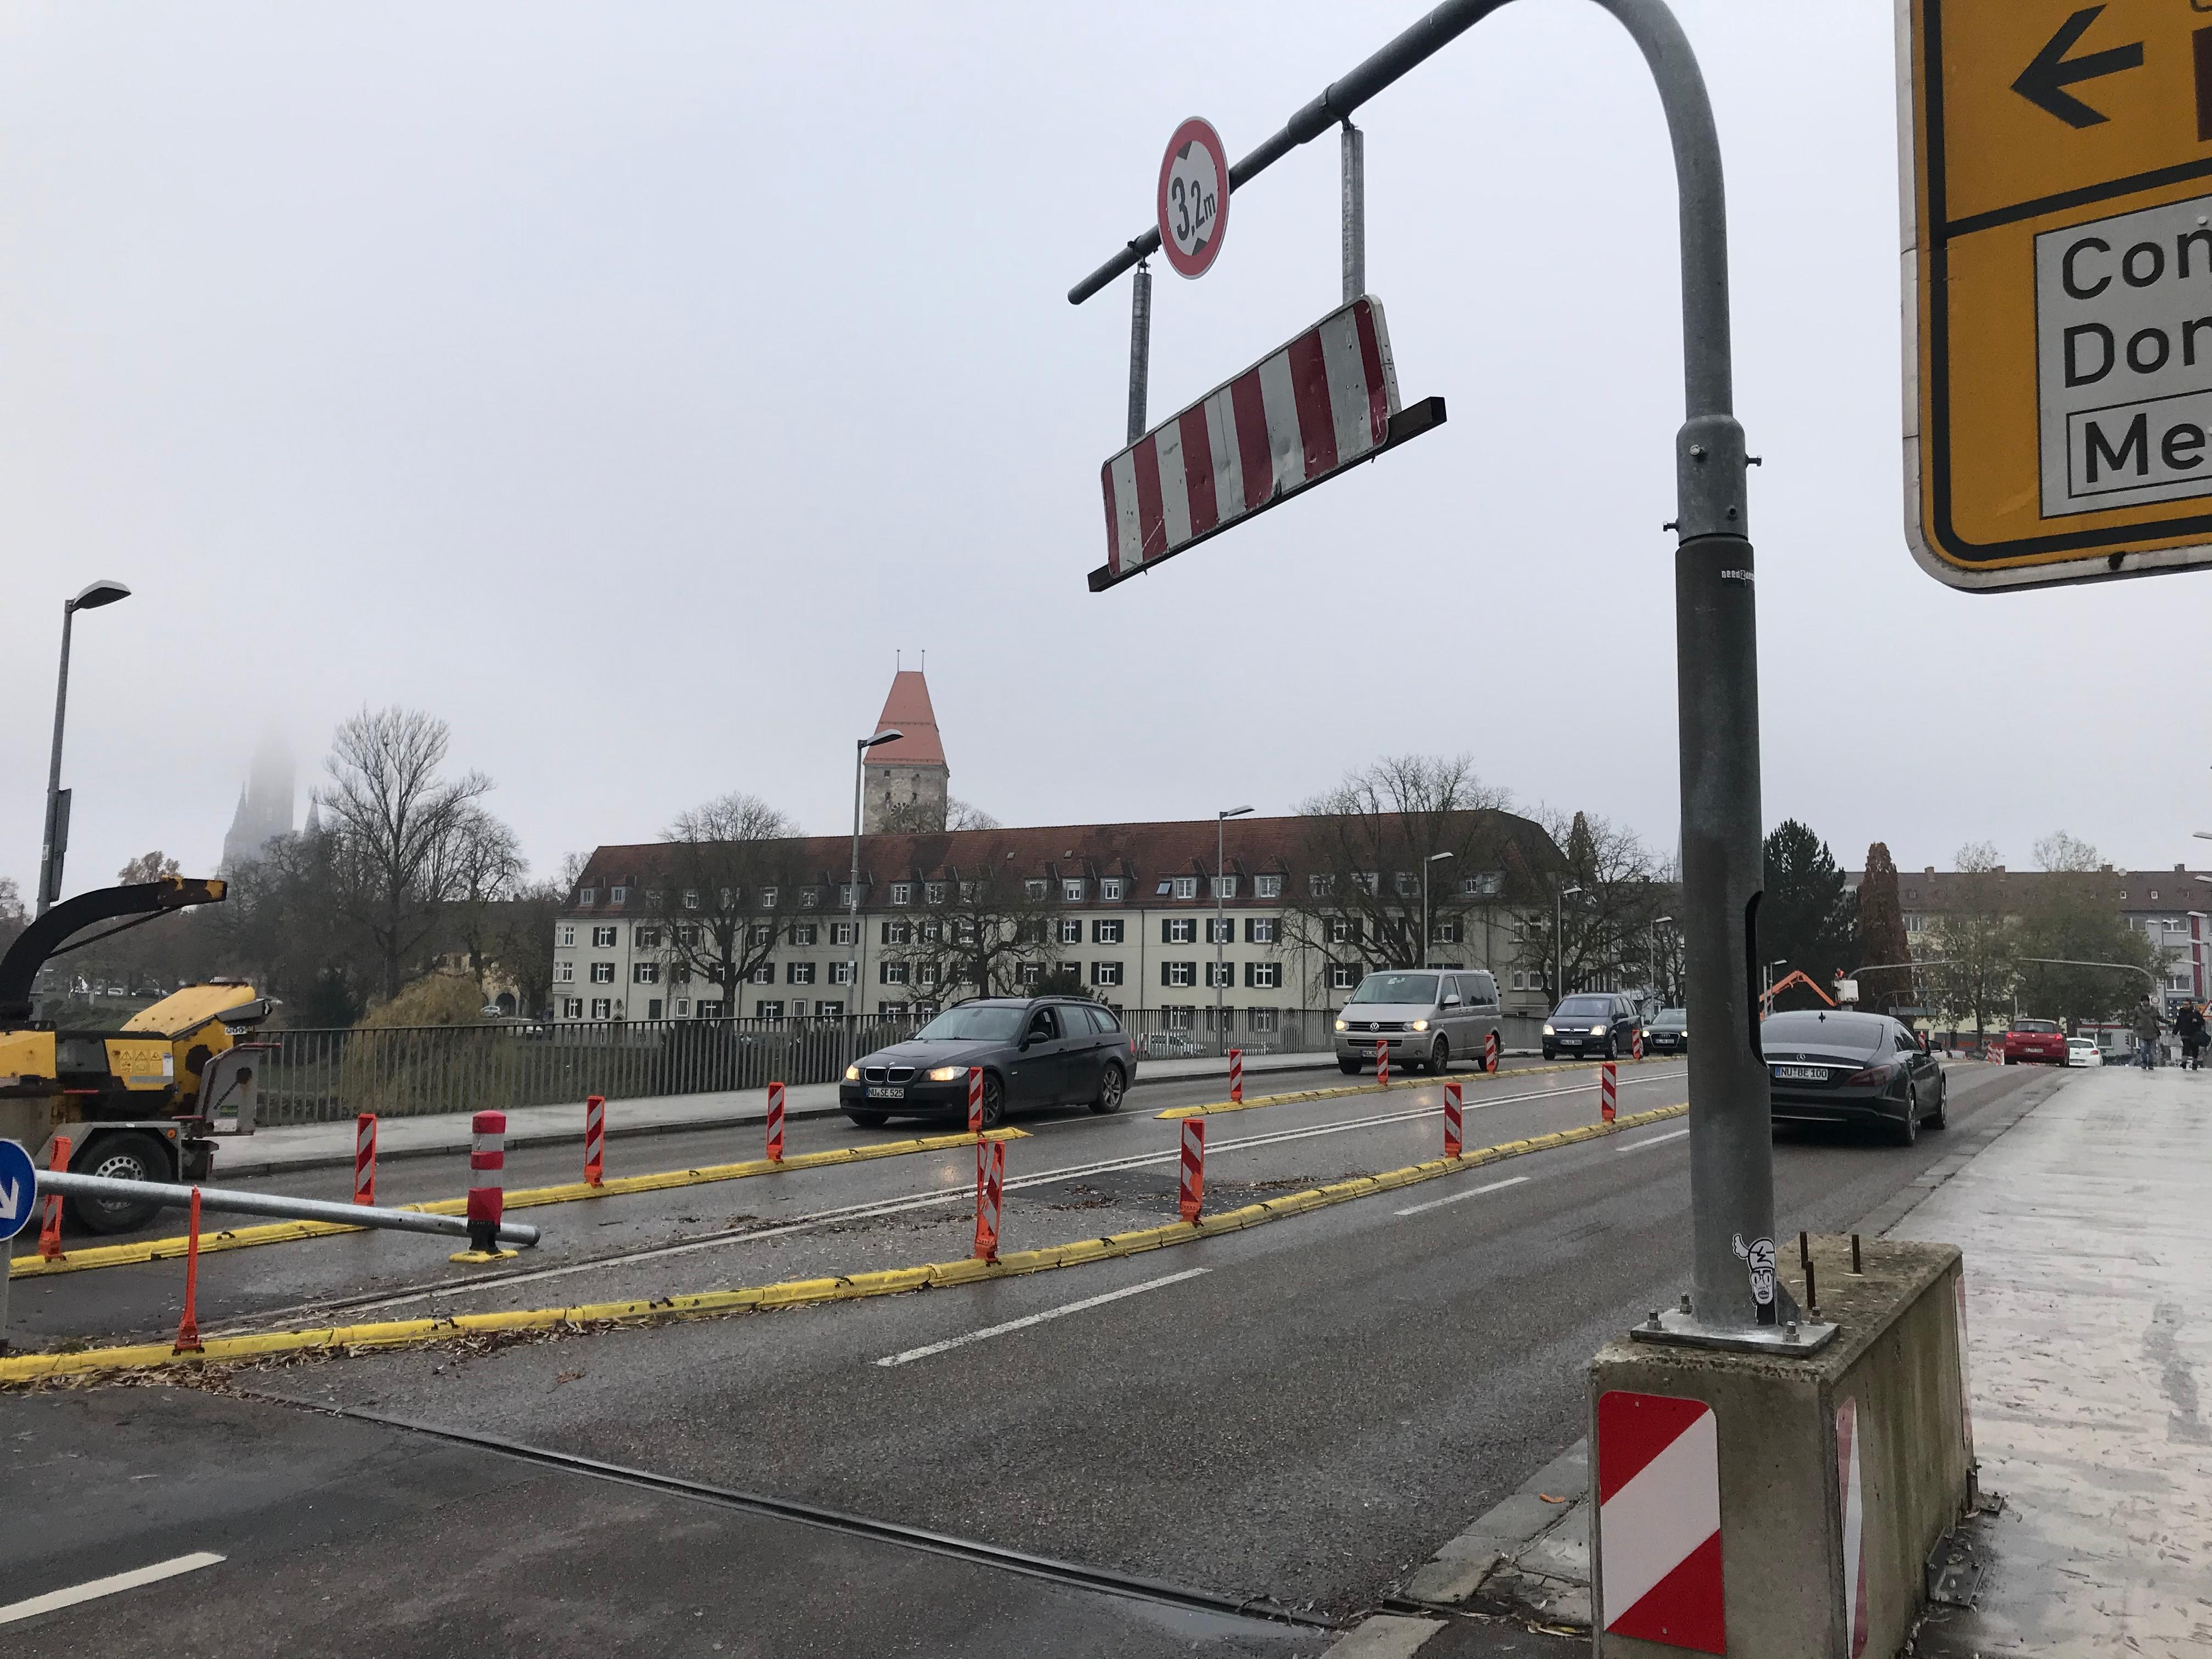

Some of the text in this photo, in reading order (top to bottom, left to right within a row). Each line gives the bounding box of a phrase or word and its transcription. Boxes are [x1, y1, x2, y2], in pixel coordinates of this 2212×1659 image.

[1781, 1068, 1792, 1076] NU
[869, 1088, 877, 1097] NU
[890, 1089, 903, 1097] 525
